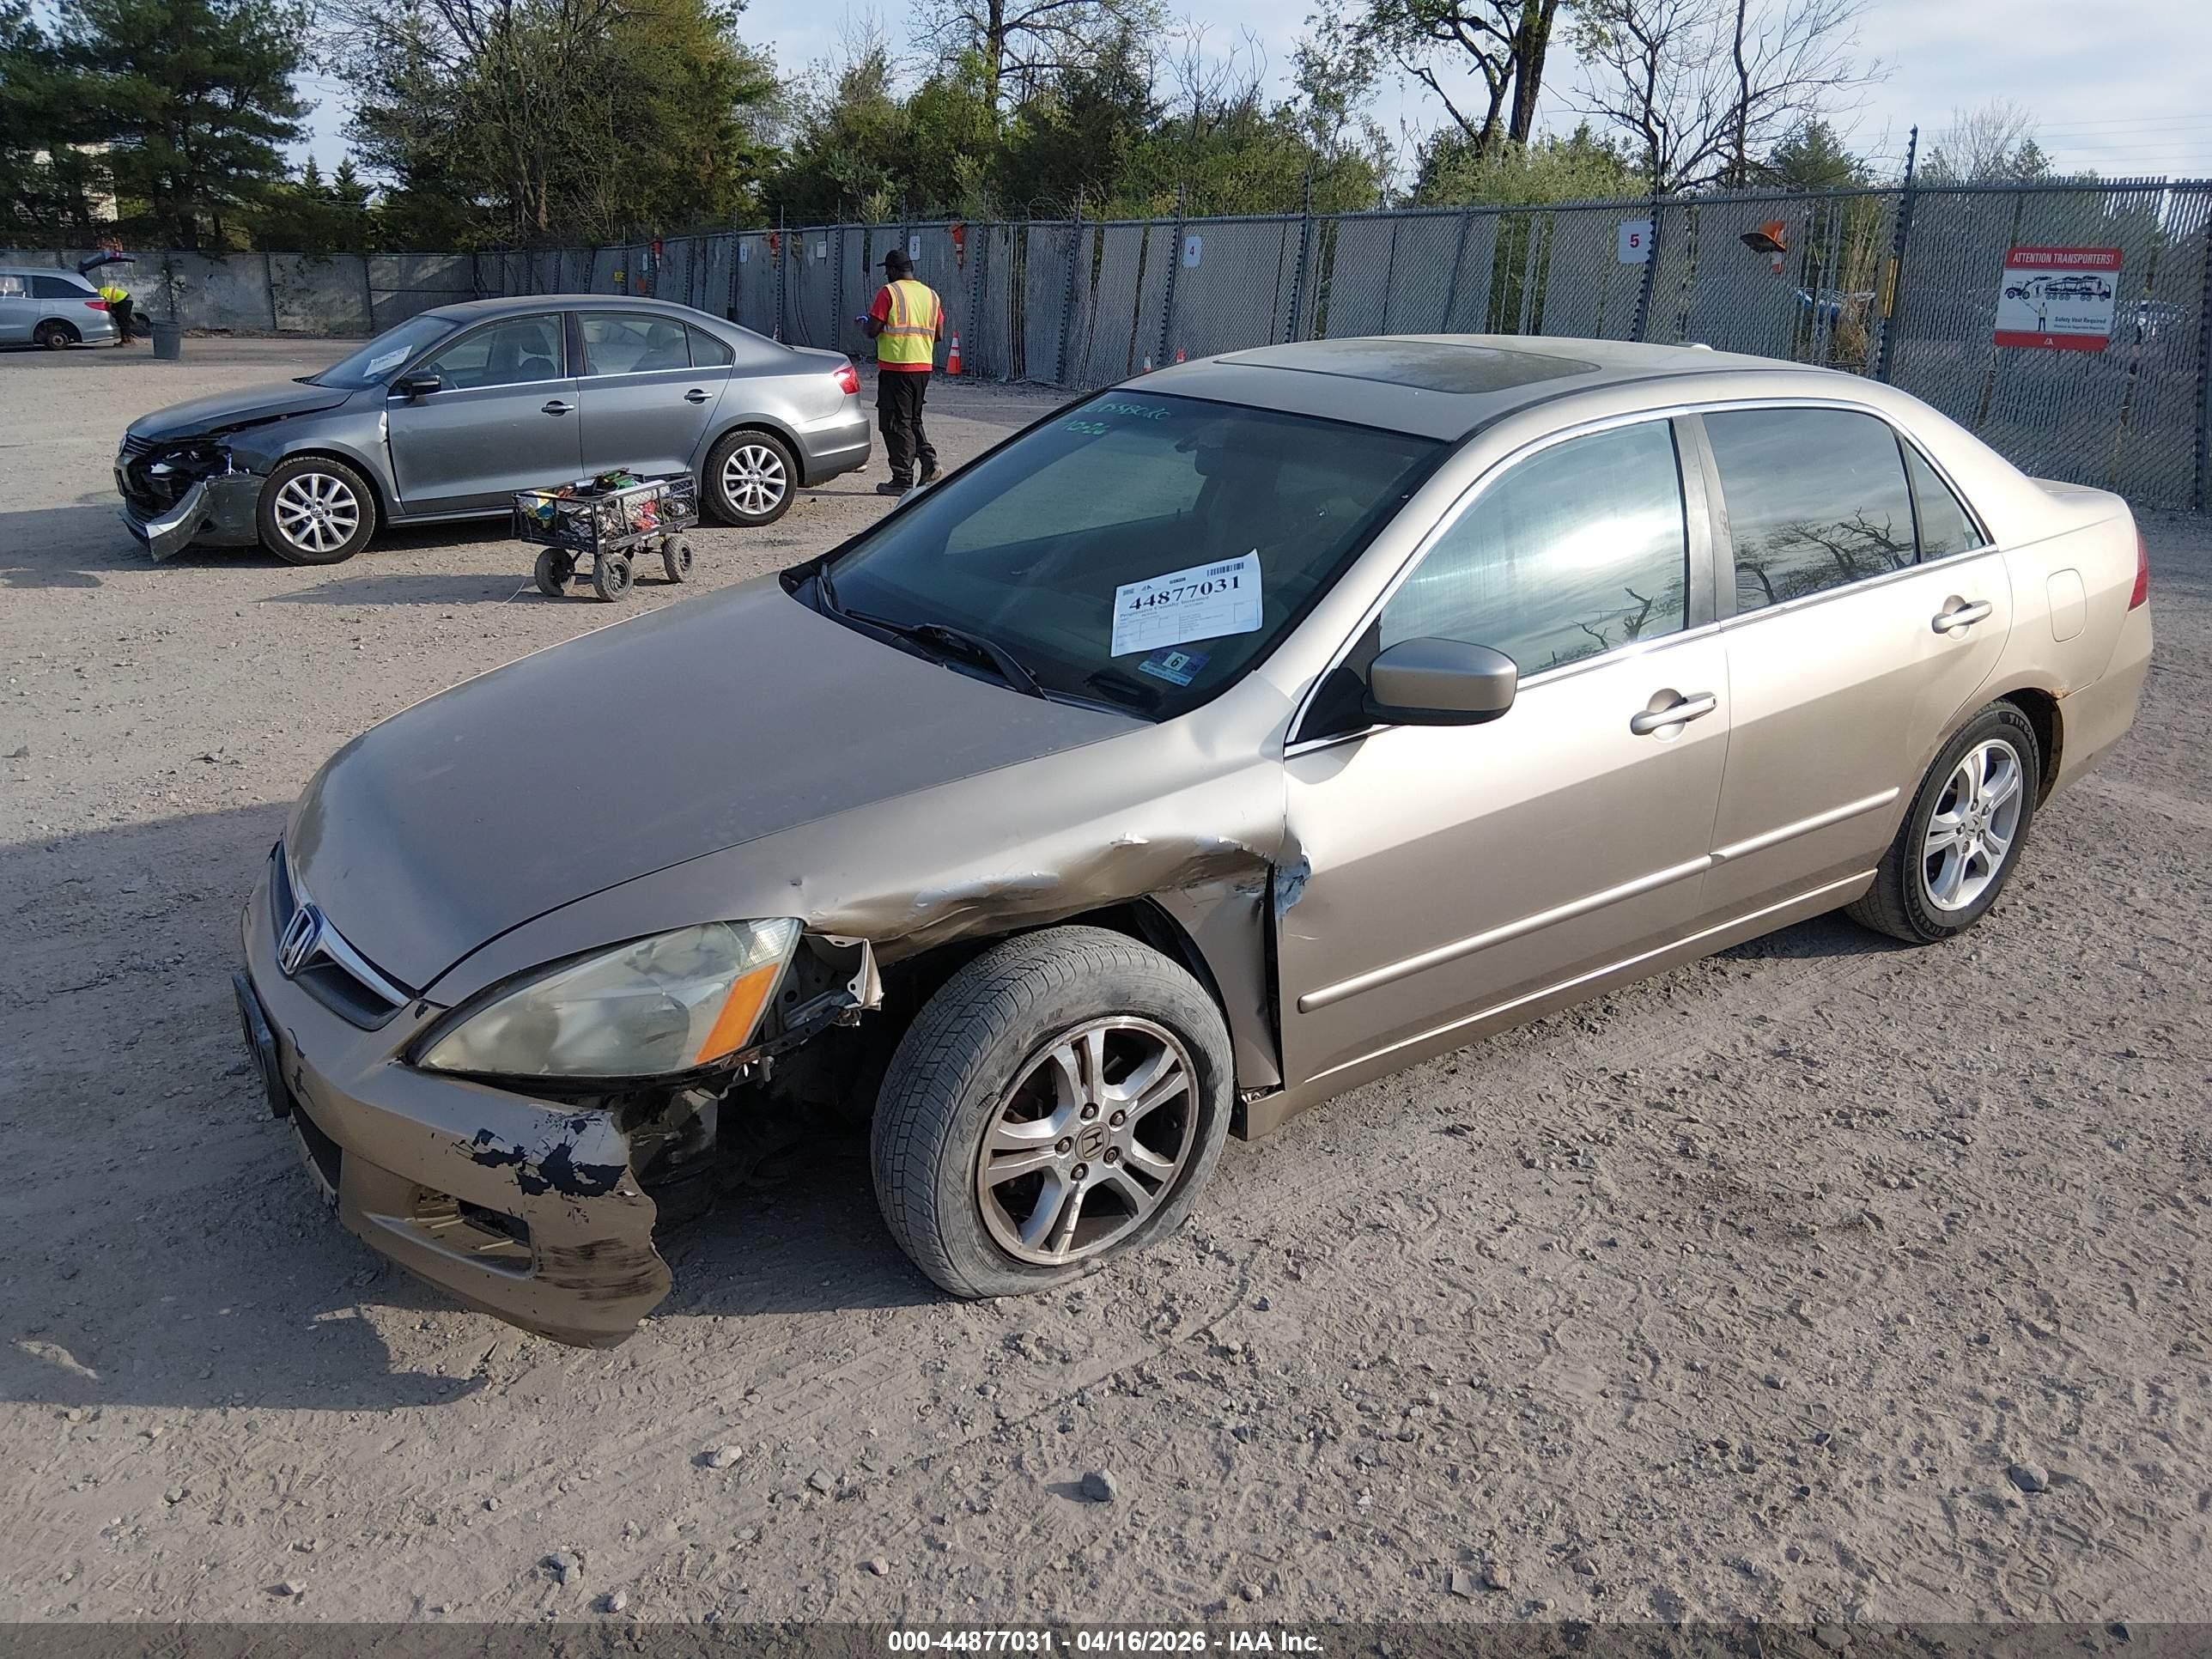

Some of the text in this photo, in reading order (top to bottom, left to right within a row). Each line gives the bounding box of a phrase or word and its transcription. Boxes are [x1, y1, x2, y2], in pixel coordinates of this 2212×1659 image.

[1630, 234, 1639, 248] 5
[1189, 246, 1194, 256] 4
[2013, 252, 2114, 265] ATTENTION TRANSPORTERS!
[1129, 575, 1242, 610] 44877031
[1170, 656, 1182, 667] 6
